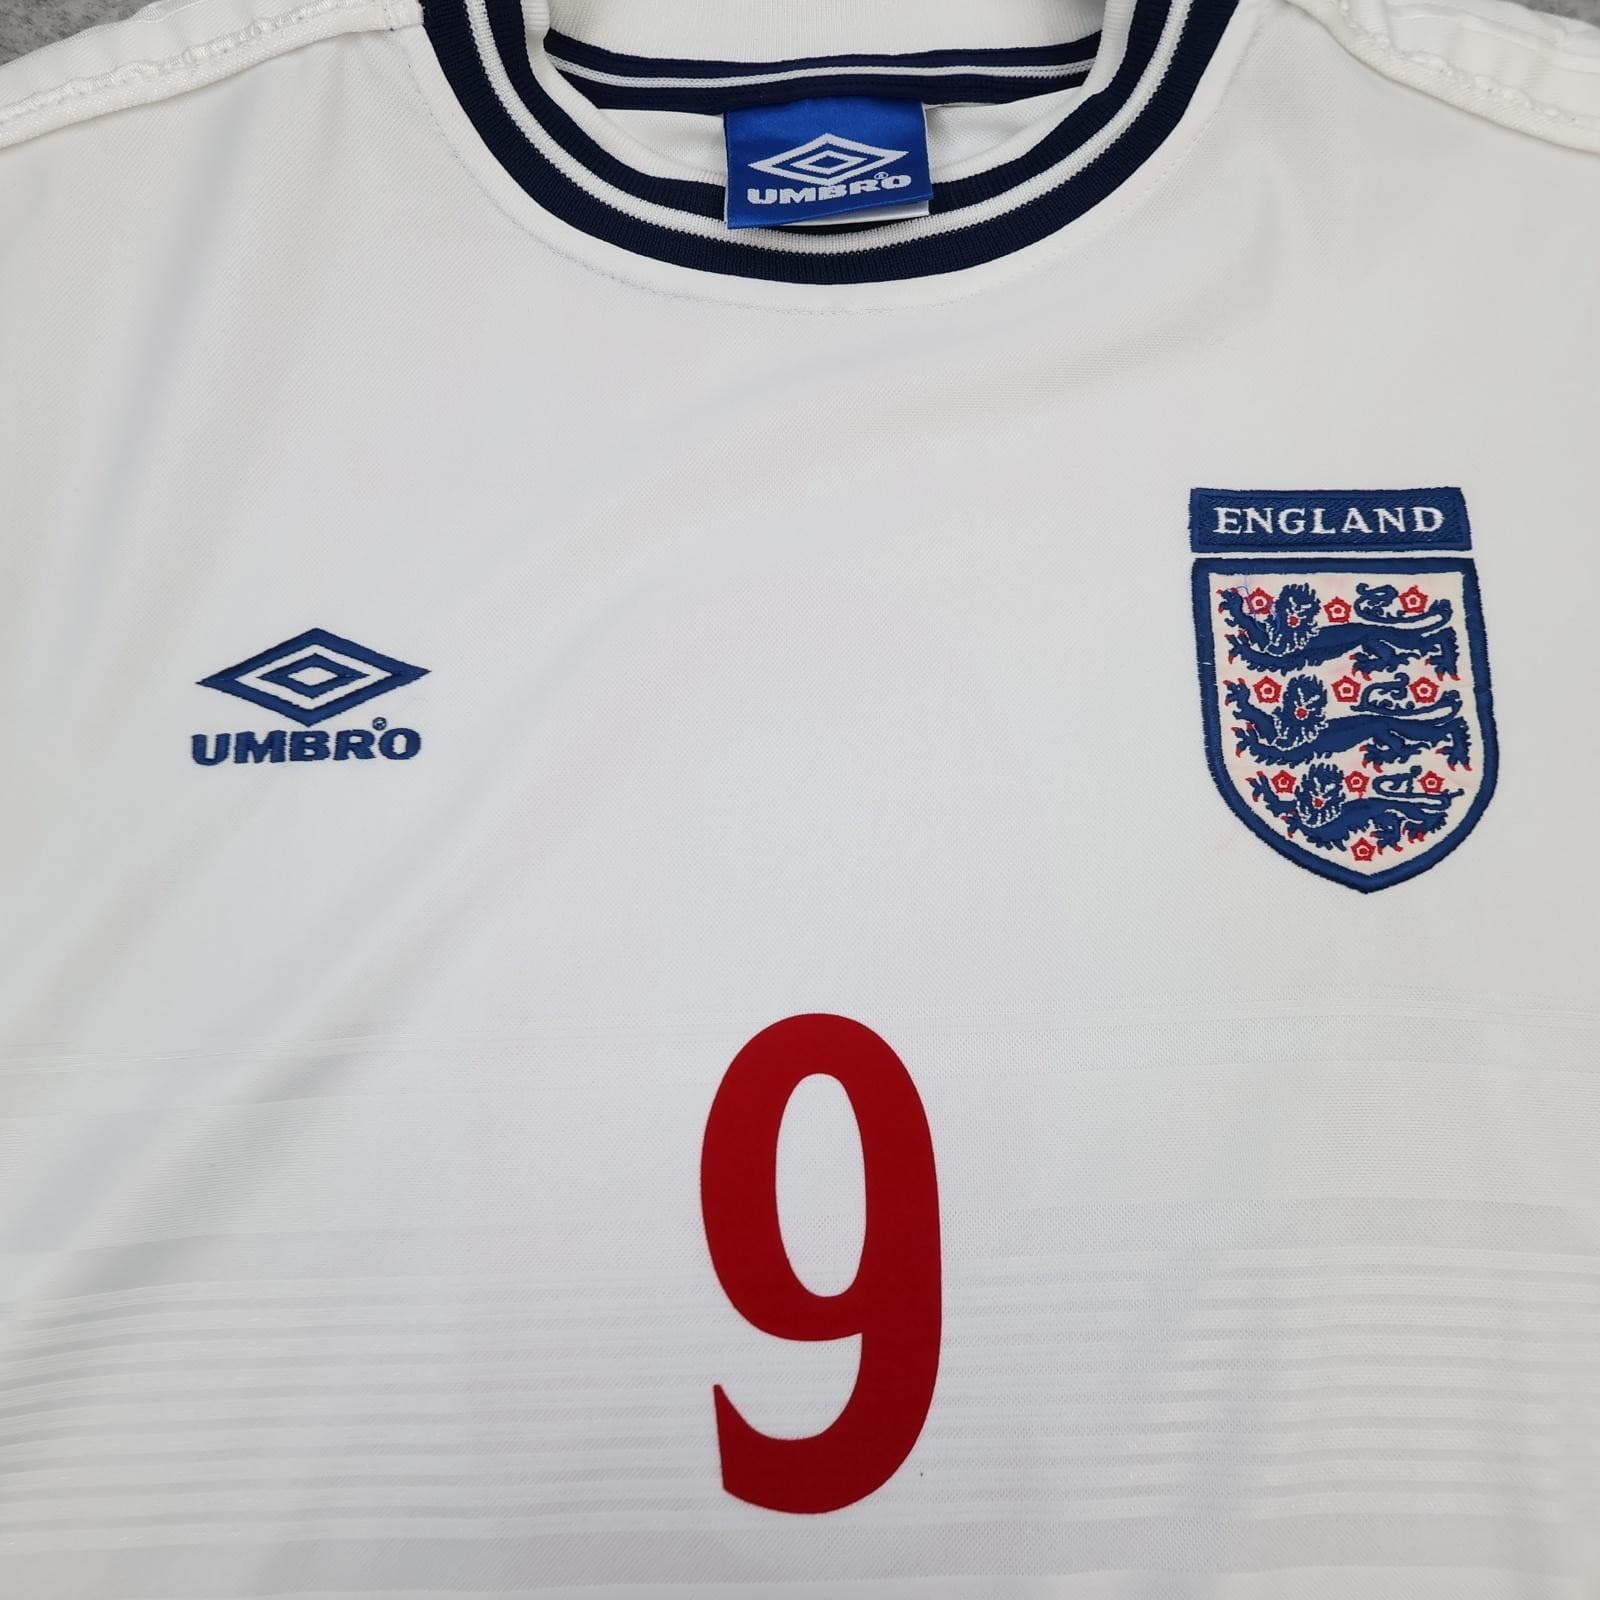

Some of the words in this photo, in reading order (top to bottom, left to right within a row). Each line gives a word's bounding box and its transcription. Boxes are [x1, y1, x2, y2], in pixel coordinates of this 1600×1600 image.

[747, 174, 912, 205] UMBRO
[1213, 505, 1445, 535] ENGLAND
[191, 727, 422, 766] UMBRO
[700, 1013, 942, 1514] 9
